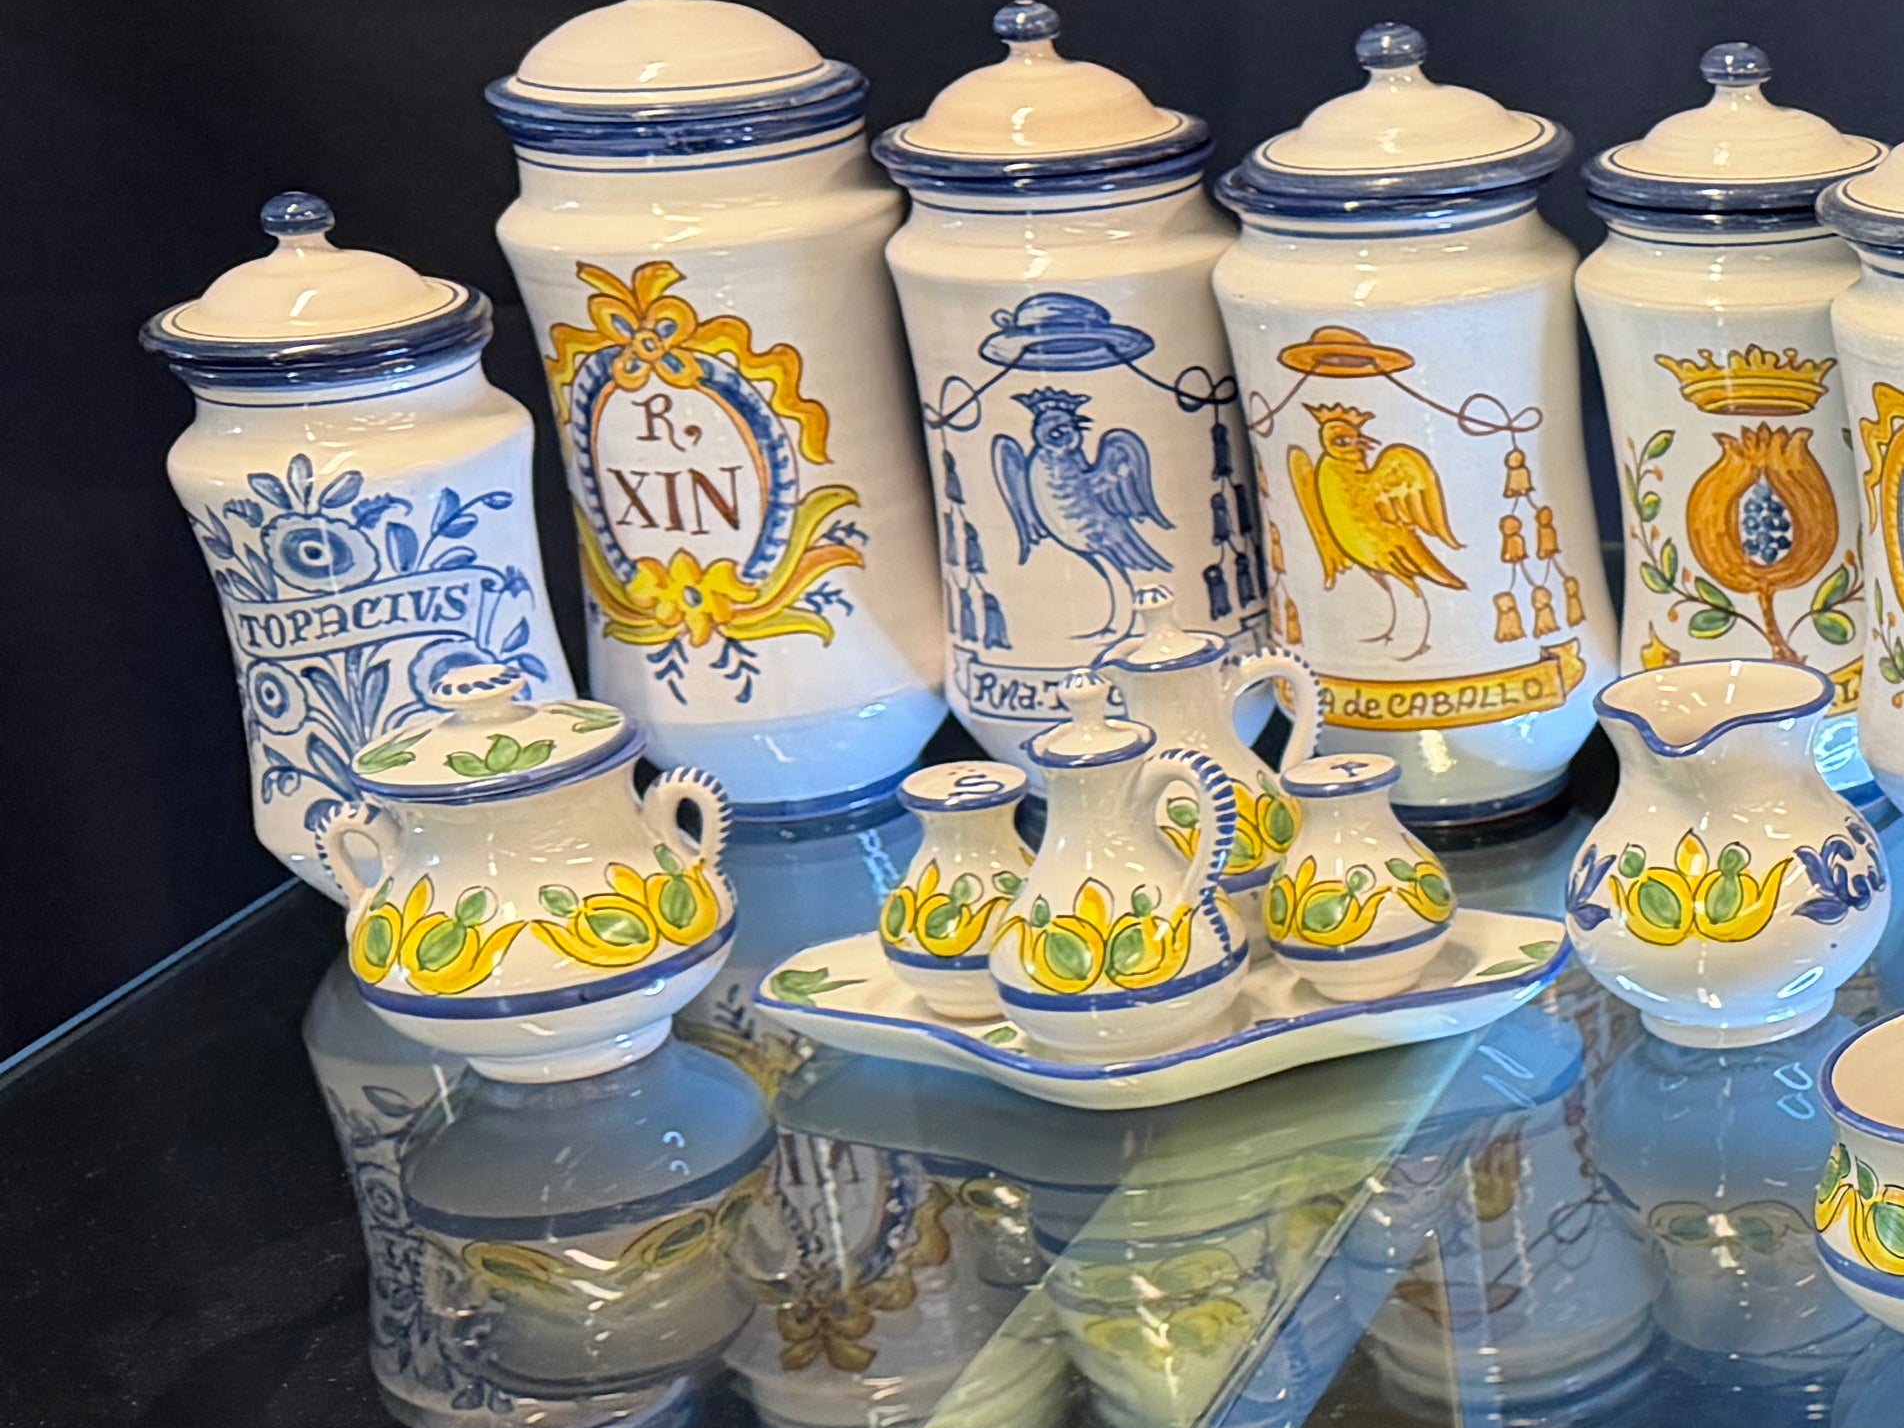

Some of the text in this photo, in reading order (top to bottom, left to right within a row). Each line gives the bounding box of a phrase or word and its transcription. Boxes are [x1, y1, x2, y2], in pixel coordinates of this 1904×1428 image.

[606, 465, 744, 535] XIN
[1343, 689, 1384, 720] de
[1387, 677, 1544, 719] CABALLO
